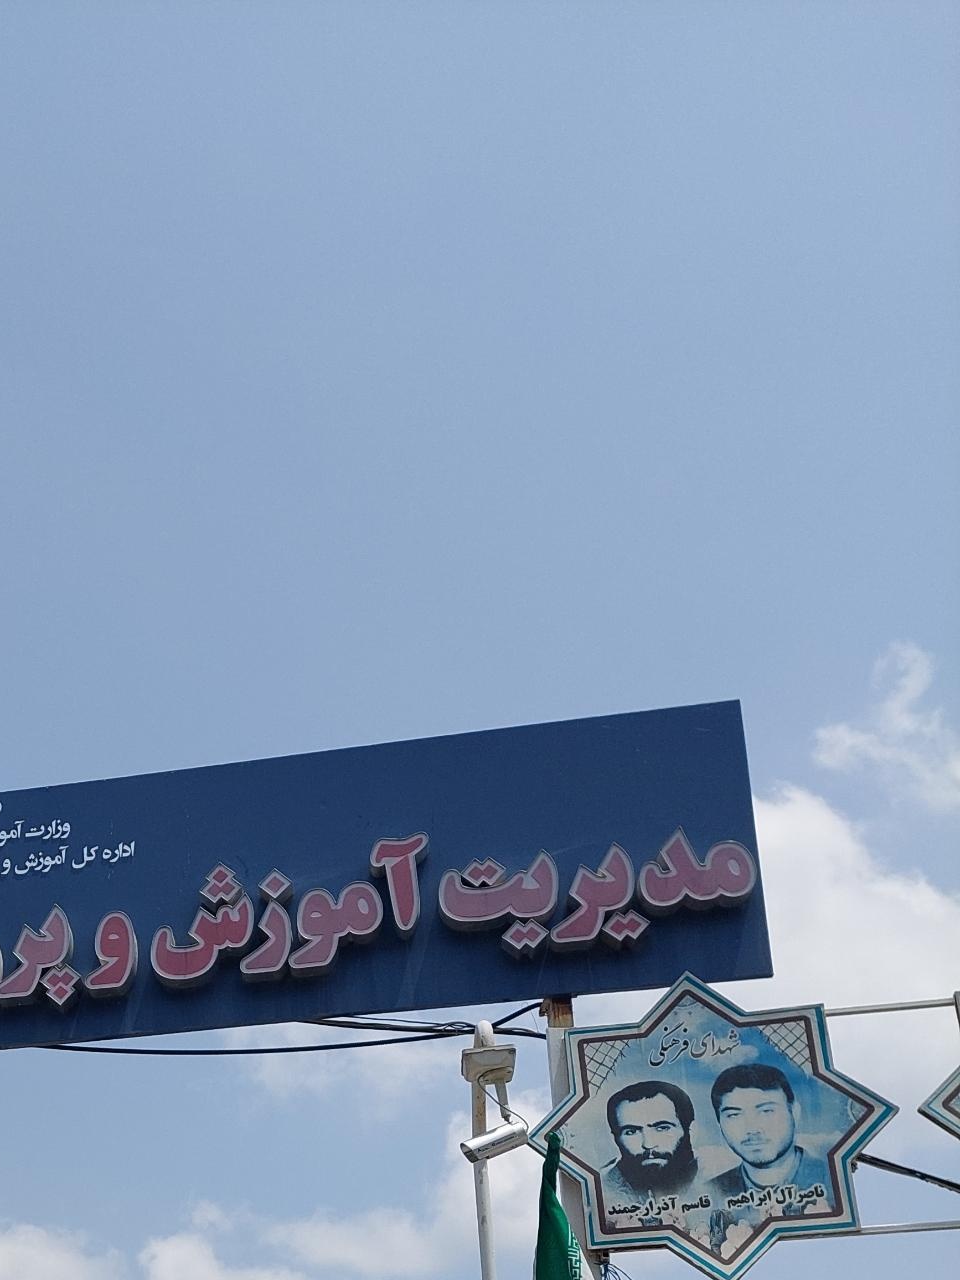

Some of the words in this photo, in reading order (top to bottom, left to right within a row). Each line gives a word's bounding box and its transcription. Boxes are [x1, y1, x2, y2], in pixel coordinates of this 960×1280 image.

[25, 819, 71, 840] وزارت
[14, 846, 69, 875] آموزش
[71, 846, 99, 869] کل
[102, 841, 136, 863] اداره
[1, 857, 11, 875] و
[439, 825, 758, 954] مدیریت
[150, 831, 430, 988] آموزش
[85, 911, 139, 1000] و
[690, 1028, 741, 1059] شهدای
[681, 1195, 712, 1213] قاسم
